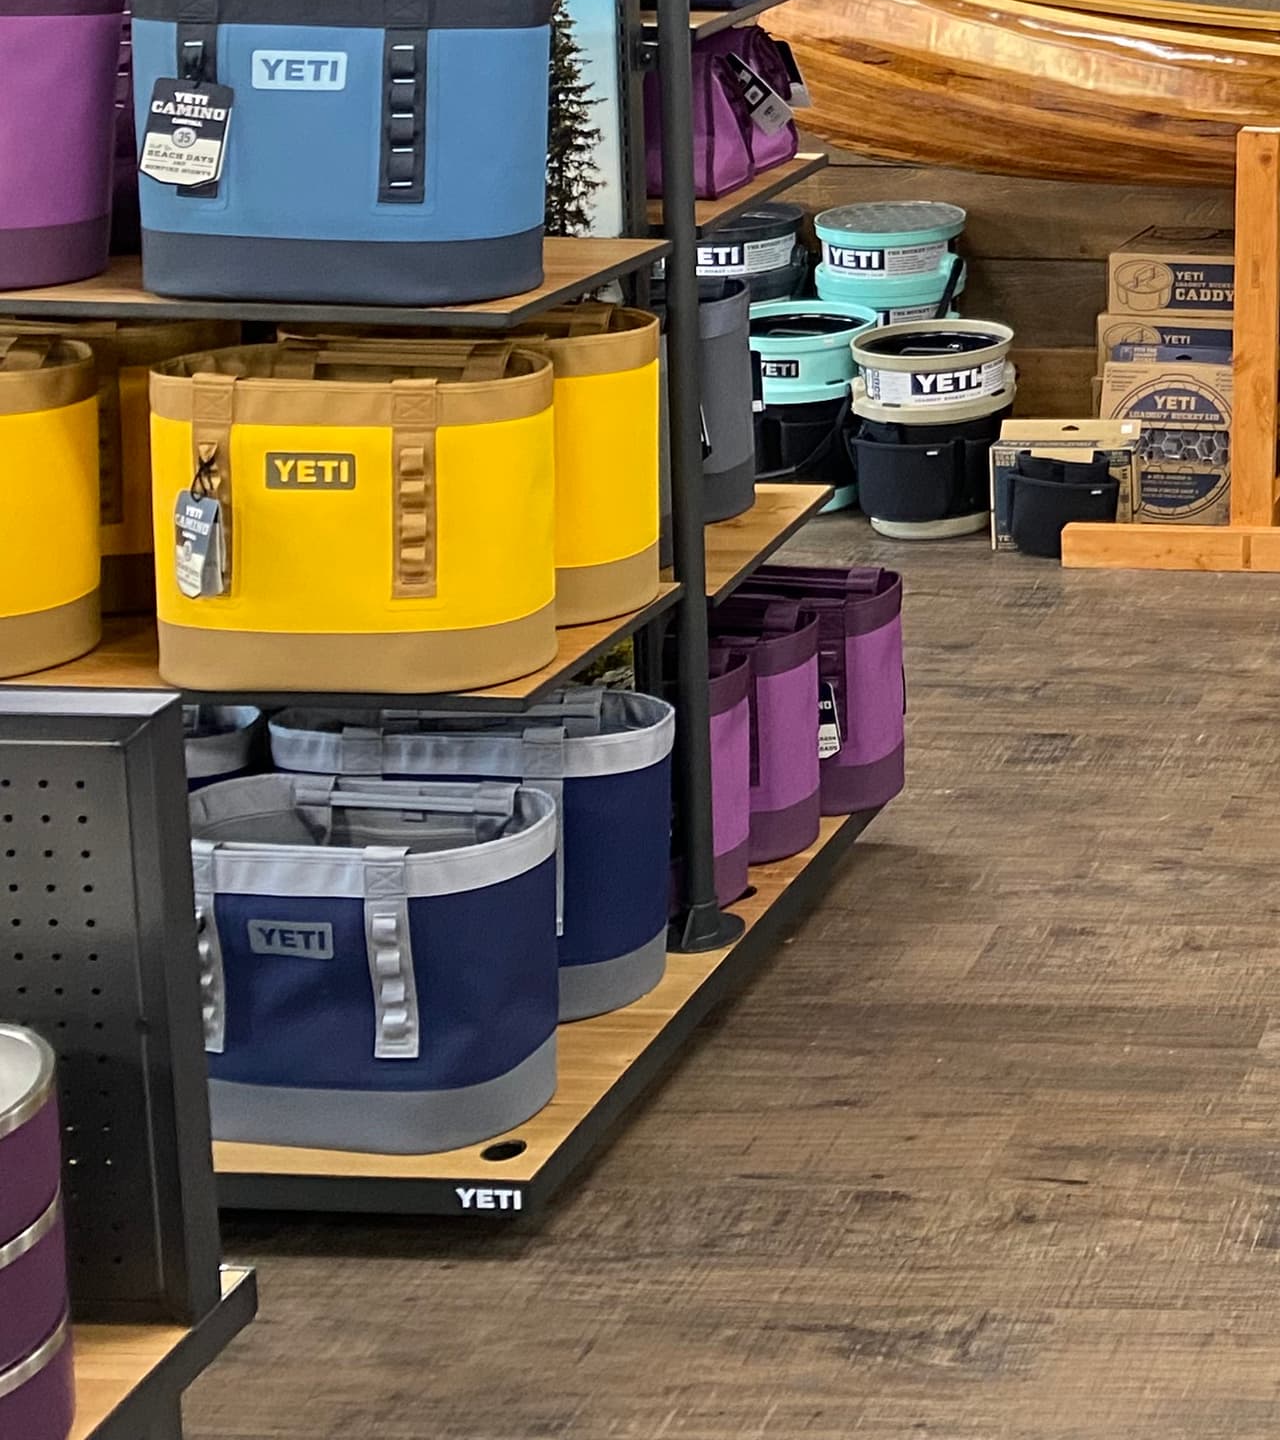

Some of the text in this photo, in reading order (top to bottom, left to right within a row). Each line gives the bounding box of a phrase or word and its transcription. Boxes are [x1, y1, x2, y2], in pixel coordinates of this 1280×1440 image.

[260, 58, 339, 82] YETI
[174, 91, 210, 106] YETI
[151, 100, 226, 121] CAMINO
[186, 153, 215, 164] DAYS
[697, 246, 740, 266] ETI
[830, 246, 880, 269] YETI
[1175, 271, 1204, 281] YETI
[1175, 288, 1235, 302] CADDY
[1163, 334, 1191, 345] YETI
[915, 370, 980, 394] YETI
[1153, 395, 1197, 411] YETI
[273, 459, 349, 482] YETI
[257, 927, 326, 951] YETI
[455, 1188, 522, 1210] YETI
